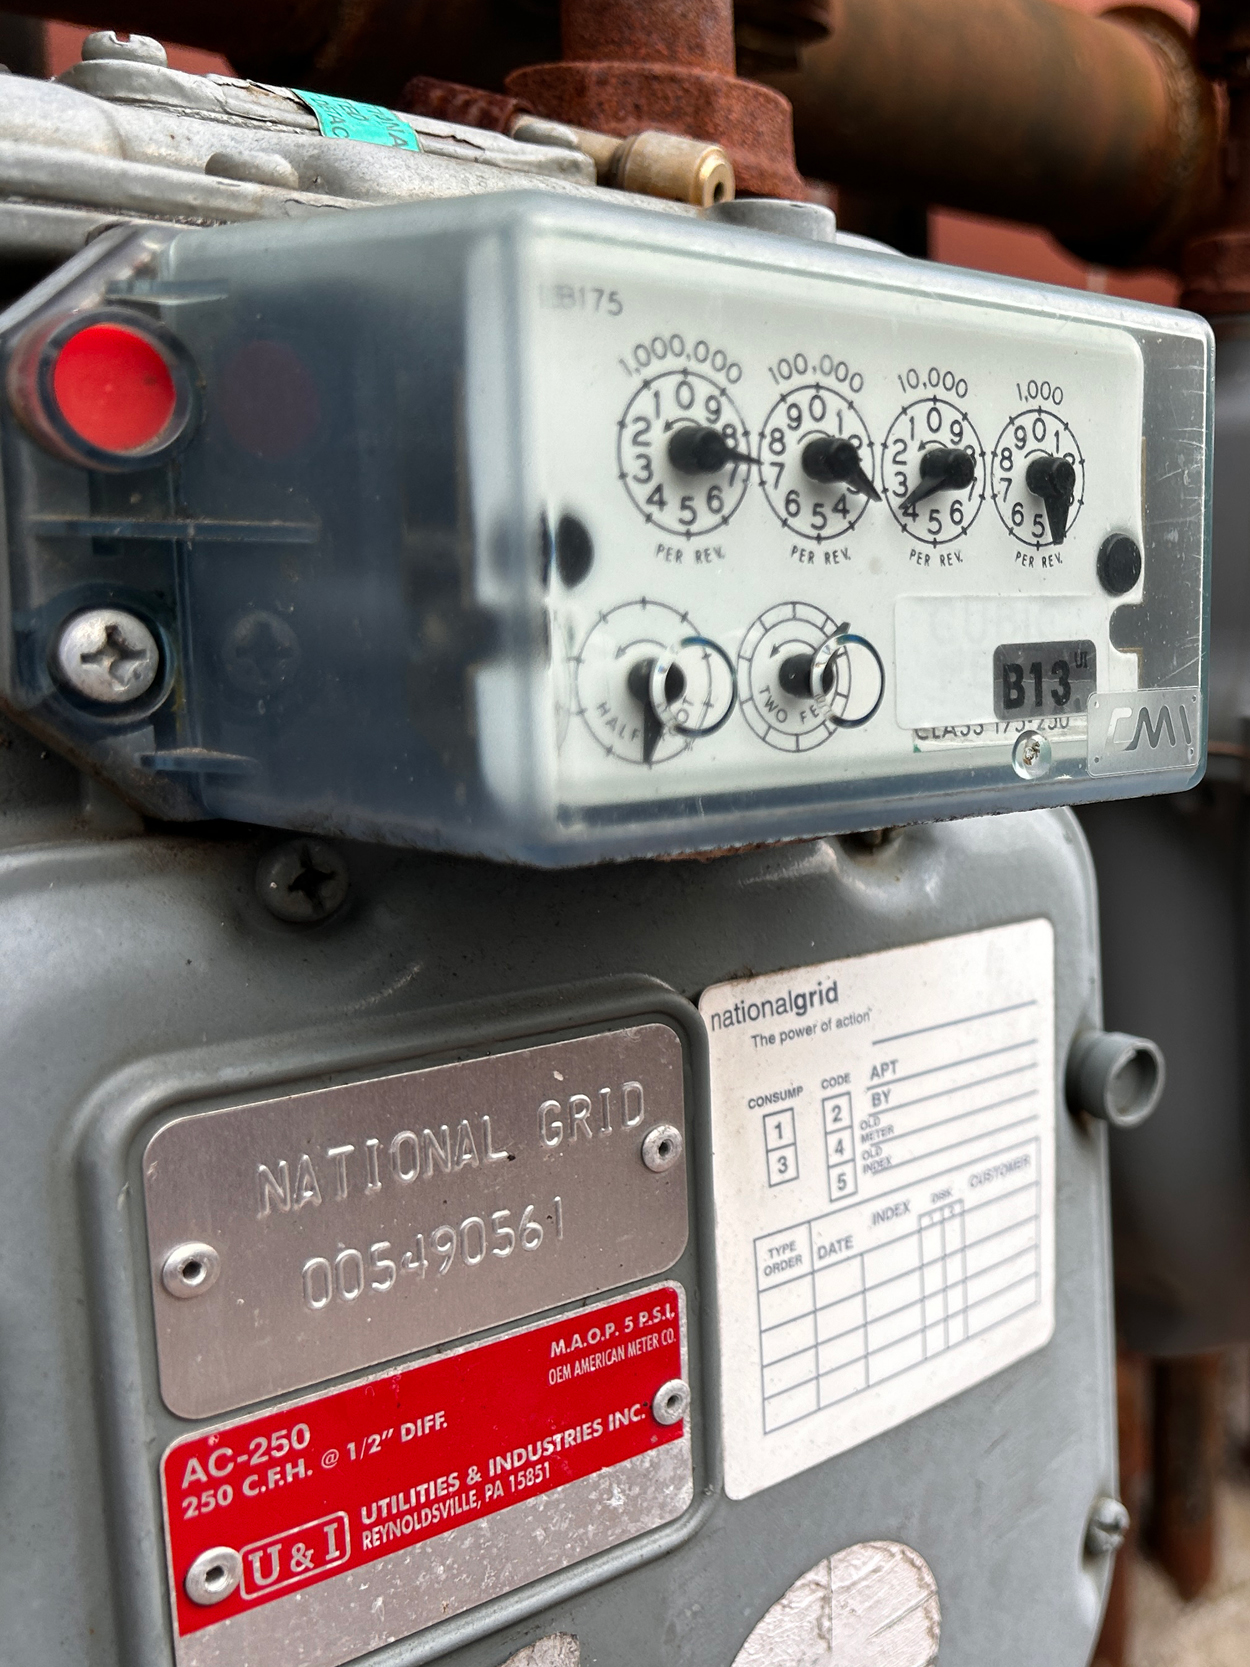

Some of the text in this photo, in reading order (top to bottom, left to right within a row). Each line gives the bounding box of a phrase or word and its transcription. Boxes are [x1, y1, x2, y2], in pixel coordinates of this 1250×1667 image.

[617, 333, 743, 385] 1,000,000
[768, 352, 864, 394] 100,000
[675, 379, 695, 411] 0
[897, 366, 969, 399] 10,000
[1016, 379, 1064, 406] 1,000
[653, 390, 661, 420] 1
[704, 394, 722, 424] 9
[786, 402, 803, 431] 9
[808, 393, 827, 423] 0
[631, 415, 652, 447] 2
[836, 408, 844, 437] 1
[908, 415, 916, 442] 1
[926, 406, 943, 434] 0
[949, 419, 964, 446] 9
[1031, 417, 1047, 443] 0
[768, 427, 787, 456] 8
[1013, 424, 1028, 451] 9
[1053, 429, 1060, 455] 1
[892, 438, 908, 466] 2
[999, 446, 1014, 473] 8
[631, 453, 654, 484] 3
[769, 461, 785, 491] 7
[645, 482, 669, 513] 4
[892, 470, 909, 499] 3
[999, 477, 1013, 503] 7
[678, 495, 698, 526] 5
[706, 484, 725, 515] 6
[785, 489, 802, 519] 6
[831, 493, 851, 520] 4
[949, 499, 965, 526] 6
[810, 502, 828, 531] 5
[927, 508, 943, 536] 5
[1011, 501, 1025, 528] 6
[1031, 513, 1046, 539] 5
[655, 543, 683, 565] PER
[790, 544, 815, 565] PER
[908, 548, 931, 567] PER
[1014, 551, 1035, 569] PER
[1002, 659, 1073, 711] B13
[758, 684, 789, 724] TWO
[597, 700, 641, 743] HALF
[710, 979, 840, 1032] nationalgrid
[750, 1032, 777, 1049] The
[779, 1023, 818, 1045] power
[821, 1017, 834, 1033] of
[820, 1072, 852, 1090] CODE
[870, 1058, 899, 1081] APT
[747, 1085, 804, 1110] CONSUMP
[871, 1087, 892, 1108] BY
[831, 1104, 843, 1123] 2
[859, 1115, 881, 1131] OLD
[773, 1121, 783, 1140] 1
[860, 1123, 895, 1144] METER
[256, 1080, 645, 1220] NATIONAL GRID
[834, 1138, 845, 1156] 4
[861, 1145, 883, 1161] OLD
[776, 1155, 789, 1175] 3
[863, 1155, 893, 1174] INDEX
[968, 1153, 1031, 1188] CUSTOMER
[836, 1172, 848, 1192] 5
[872, 1199, 912, 1226] INDEX
[301, 1195, 565, 1310] 005490561
[767, 1240, 798, 1259] TYPE
[816, 1234, 854, 1260] DATE
[763, 1253, 803, 1277] ORDER
[550, 1322, 620, 1358] M.A.O.P.
[624, 1316, 634, 1333] 5
[548, 1327, 677, 1386] OEM AMERICAN METER CO.
[181, 1422, 312, 1490] AC-250
[181, 1484, 234, 1521] 250
[241, 1457, 314, 1497] C.F.H.
[320, 1448, 340, 1470] @
[400, 1410, 448, 1443] DIFF.
[360, 1402, 646, 1525] UTILITIES & INDUSTRIES INC.
[361, 1460, 551, 1551] REYNOLDSVILLE, PA 15851
[247, 1522, 341, 1586] U & I
